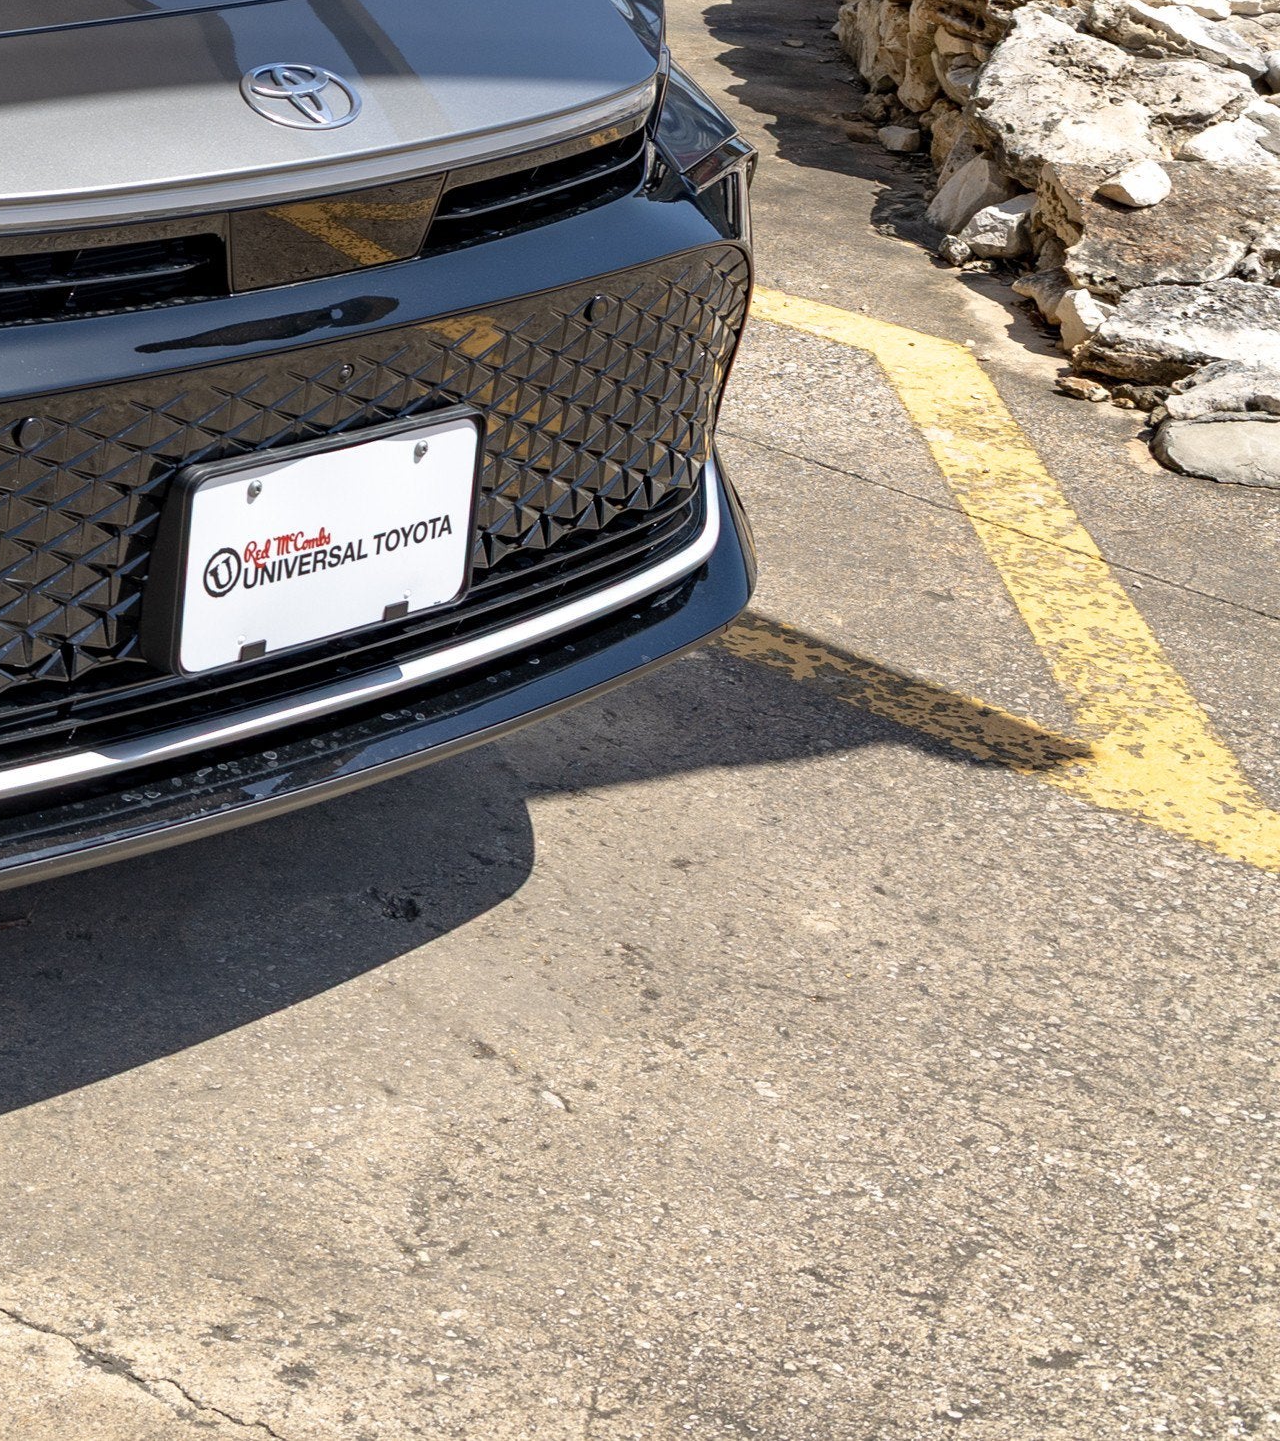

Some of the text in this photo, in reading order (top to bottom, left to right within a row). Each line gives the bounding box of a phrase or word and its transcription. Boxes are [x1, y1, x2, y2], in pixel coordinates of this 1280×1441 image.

[243, 514, 452, 589] UNIVERSAL TOYOTA
[244, 526, 331, 569] Red McCombs
